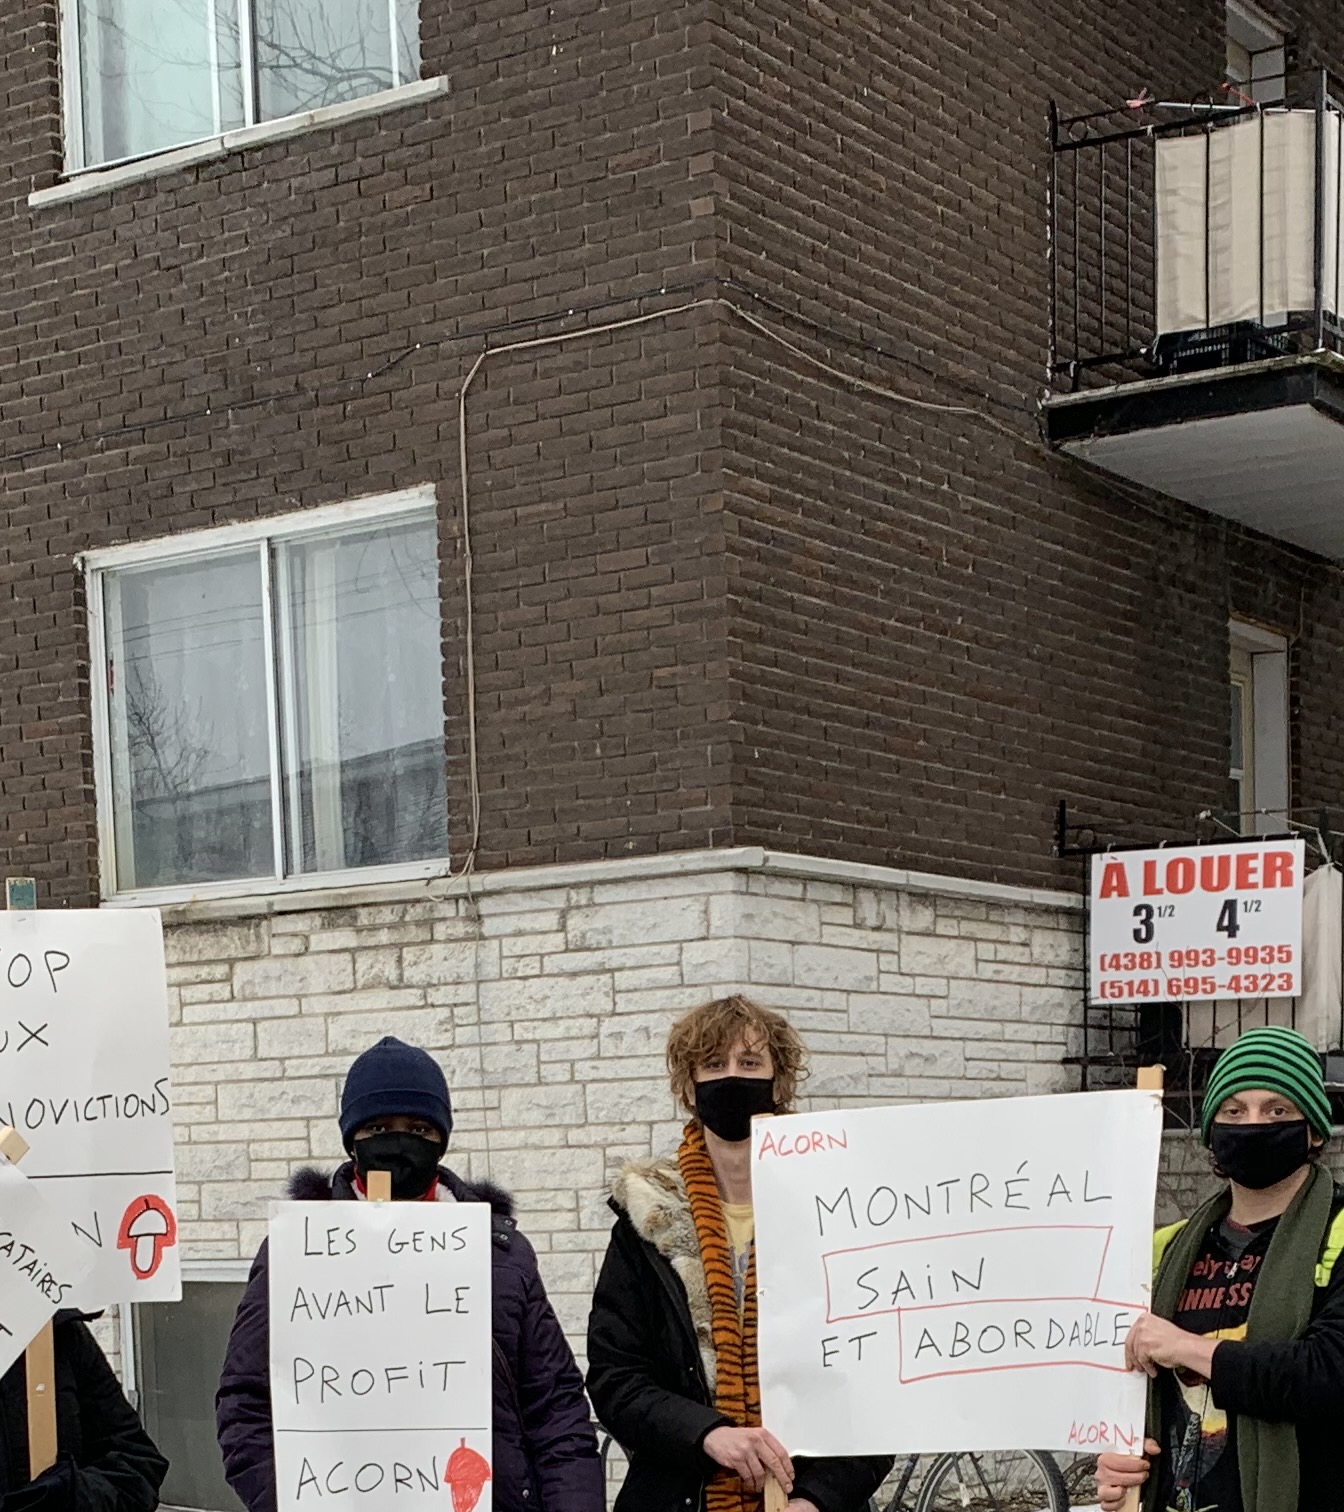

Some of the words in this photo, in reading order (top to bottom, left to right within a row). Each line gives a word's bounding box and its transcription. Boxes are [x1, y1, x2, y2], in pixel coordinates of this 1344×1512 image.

[1143, 851, 1295, 897] LOUER
[1132, 903, 1155, 945] 3
[1157, 904, 1176, 918] 1/2
[1215, 898, 1240, 939] 4
[1243, 899, 1263, 914] 1/2
[1099, 950, 1163, 973] (438)
[1168, 944, 1293, 969] 993-9935
[1099, 977, 1160, 999] (514)
[1166, 972, 1294, 998] 695-4323
[757, 1128, 849, 1161] ACORN
[814, 1160, 1113, 1237] MONTRÉAL
[304, 1215, 357, 1257] LES
[387, 1226, 468, 1254] GENS
[290, 1283, 395, 1323] AVANT
[425, 1283, 471, 1315] LE
[820, 1331, 879, 1368] ET
[914, 1311, 1131, 1360] ABORDABLE
[1067, 1419, 1135, 1447] ACORN
[295, 1455, 440, 1501] ACORN
